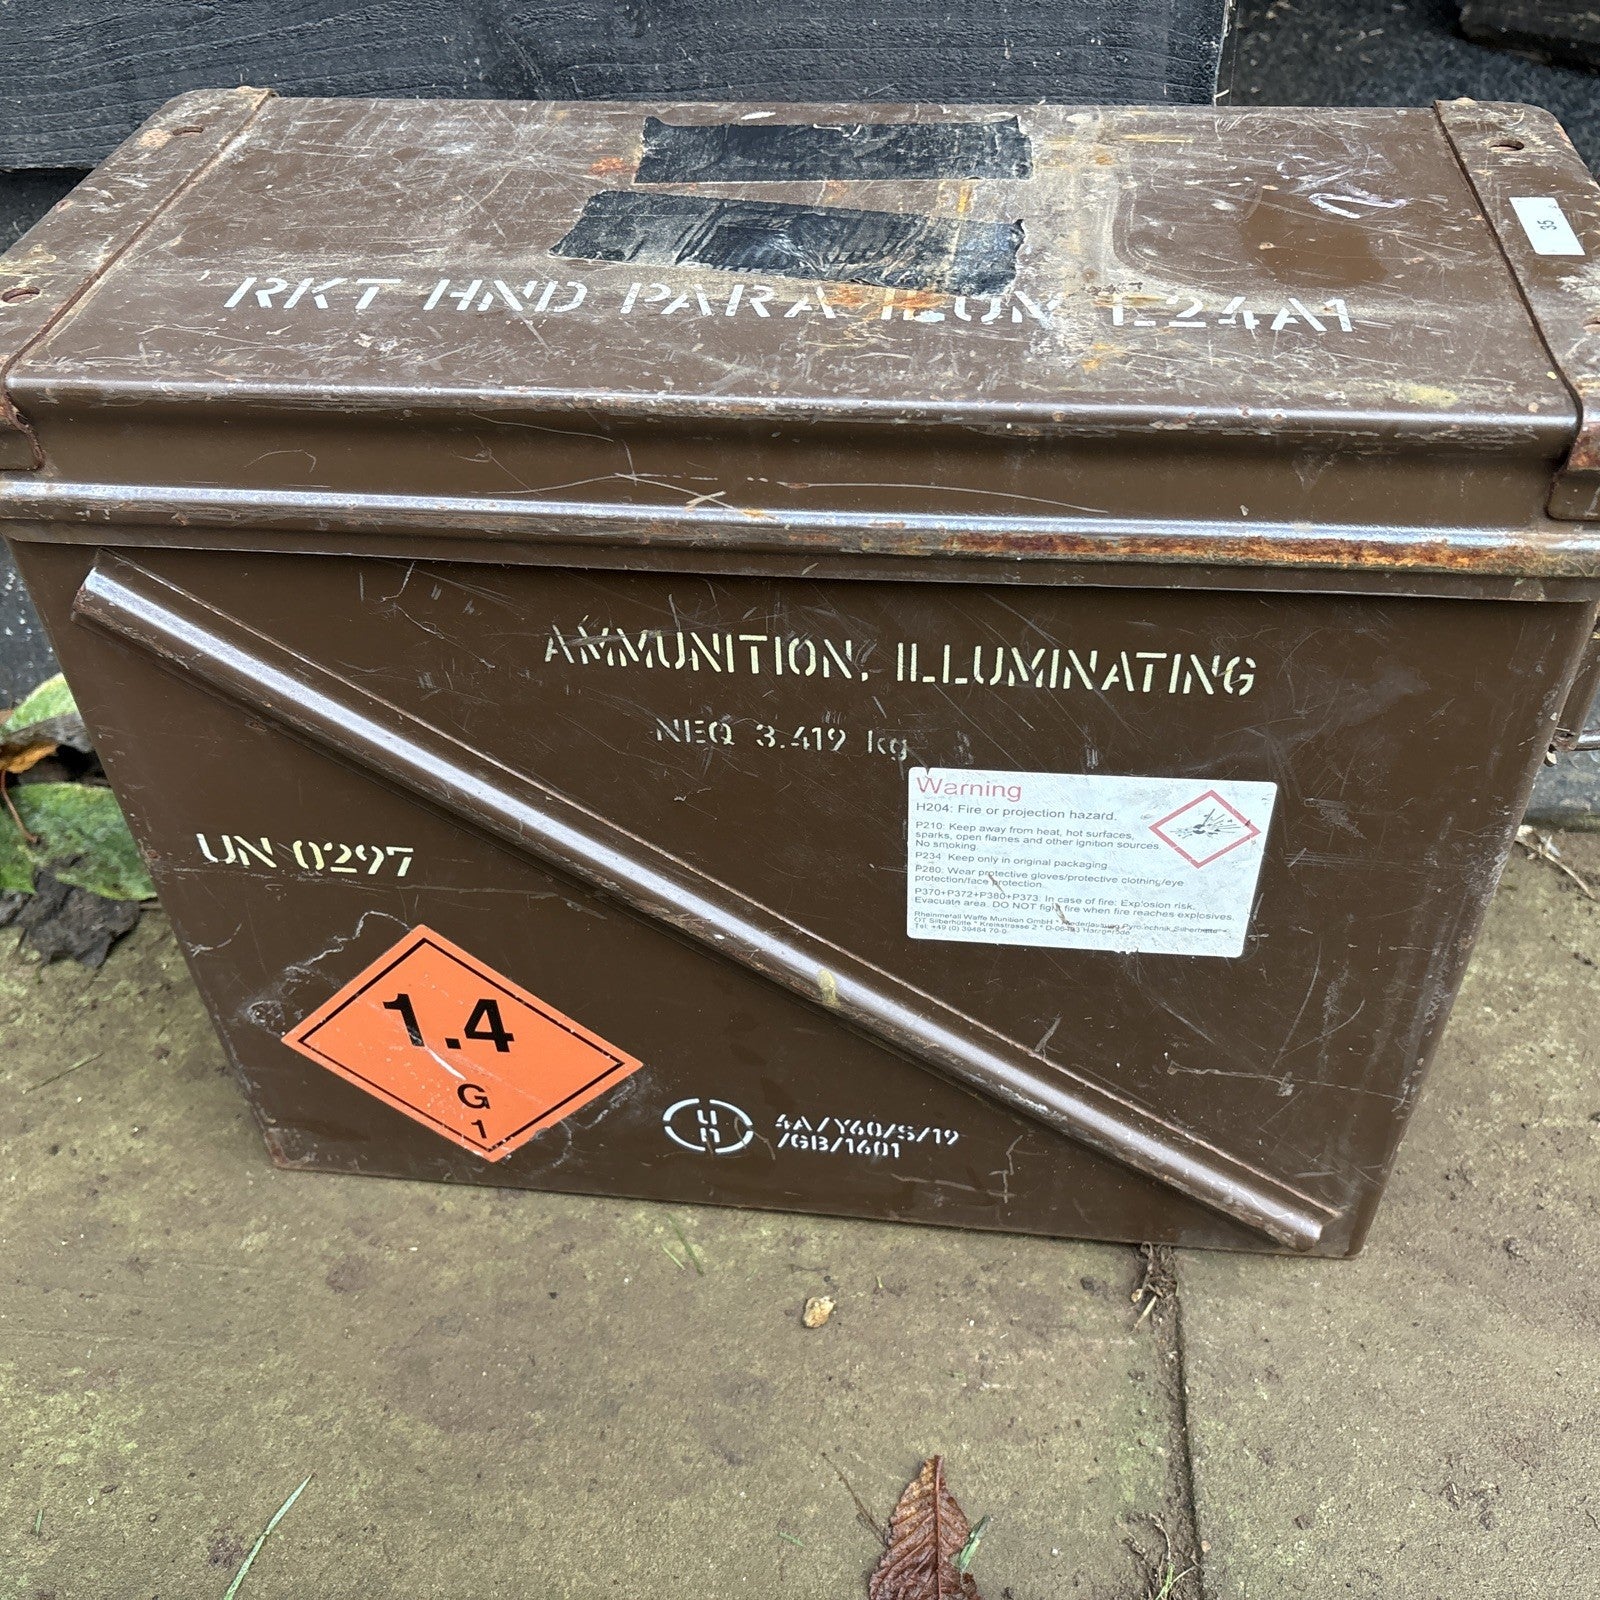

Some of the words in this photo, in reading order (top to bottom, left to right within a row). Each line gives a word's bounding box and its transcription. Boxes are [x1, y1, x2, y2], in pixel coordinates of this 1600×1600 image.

[223, 276, 401, 310] RKT
[423, 278, 588, 313] HND
[619, 282, 837, 320] PARA
[1111, 293, 1354, 333] L24A1
[896, 642, 1257, 697] ILLUMINATING
[655, 716, 736, 746] NEQ
[755, 723, 847, 752] 3.419
[867, 730, 909, 761] kg
[916, 776, 1022, 803] Warning
[916, 802, 953, 814] H204:
[958, 804, 982, 814] Fire
[986, 807, 1000, 815] or
[1003, 807, 1065, 819] projection
[1069, 809, 1118, 821] hazard.
[949, 822, 977, 833] Keep
[980, 825, 1007, 835] away
[1009, 825, 1034, 835] from
[1036, 827, 1062, 838] heat,
[1066, 828, 1083, 838] hot
[956, 833, 982, 842] open
[984, 833, 1020, 844] flames
[1023, 836, 1043, 845] and
[1045, 837, 1073, 847] other
[1076, 838, 1114, 849] ignition
[195, 832, 278, 869] UN
[292, 839, 415, 877] 0297
[915, 839, 931, 848] No
[948, 853, 975, 864] Keep
[977, 855, 999, 865] only
[1001, 856, 1011, 864] in
[1013, 857, 1051, 868] original
[915, 874, 989, 886] protection/face
[947, 866, 976, 876] Wear
[978, 869, 1029, 880] protective
[1031, 871, 1118, 884] gloves/protective
[914, 895, 961, 906] Evacuate
[992, 900, 1010, 909] DO
[1012, 901, 1038, 911] NOT
[1064, 904, 1081, 913] fire
[1083, 905, 1111, 915] when
[1113, 907, 1130, 917] fire
[1133, 908, 1175, 919] reaches
[1177, 910, 1236, 922] explosives.
[1045, 894, 1055, 903] In
[1058, 897, 1082, 905] case
[1085, 897, 1096, 905] of
[1098, 898, 1118, 907] fire:
[1120, 899, 1171, 910] Explosion
[964, 913, 988, 922] Waffe
[990, 914, 1024, 924] Munition
[1026, 916, 1053, 925] GmbH
[382, 992, 515, 1053] 1.4
[457, 1083, 491, 1110] G
[470, 1118, 488, 1140] 1
[774, 1113, 960, 1146] 4A/Y60/S/19
[776, 1132, 900, 1159] /GB/1601
